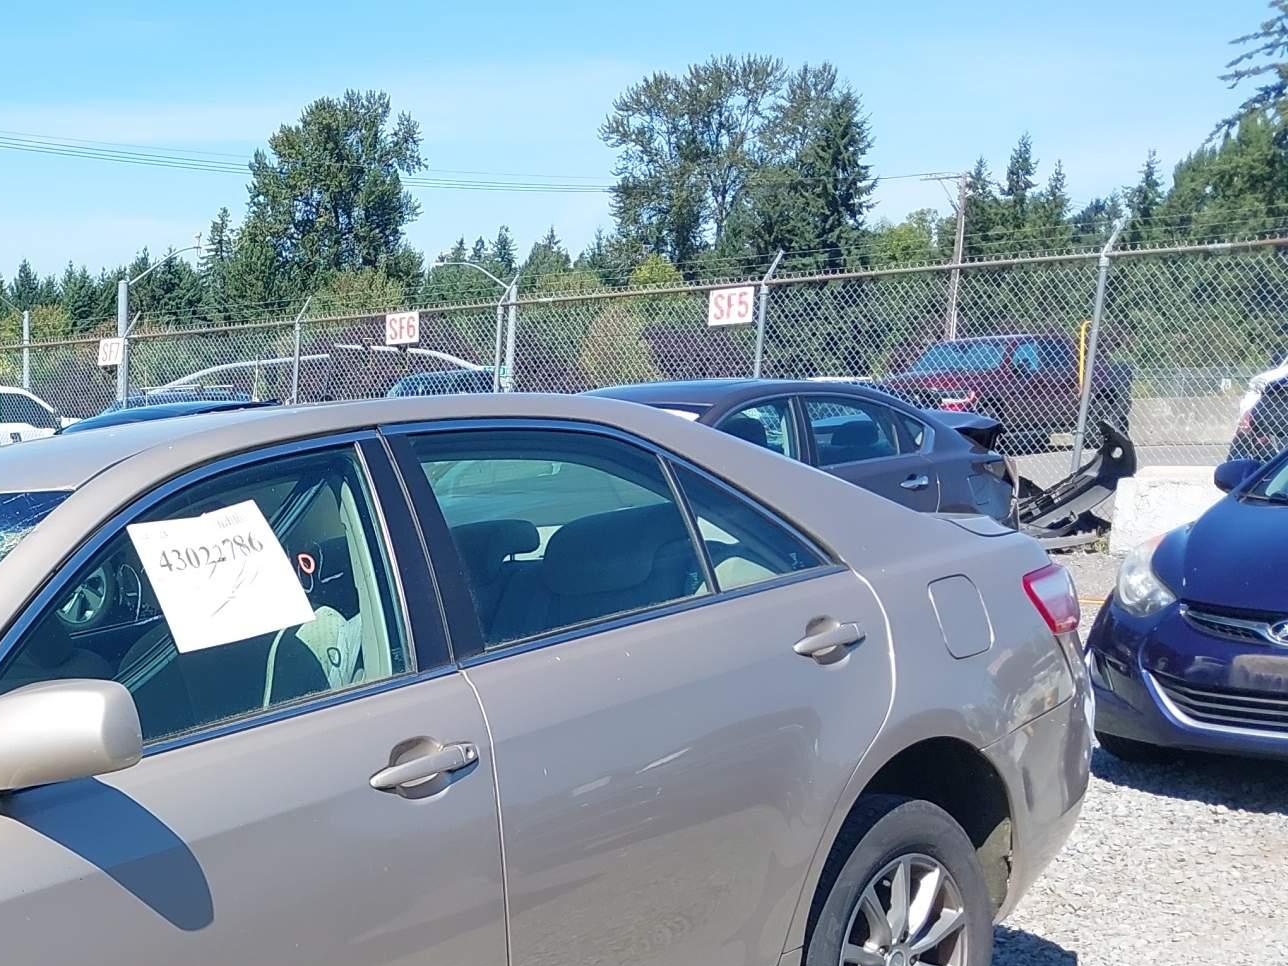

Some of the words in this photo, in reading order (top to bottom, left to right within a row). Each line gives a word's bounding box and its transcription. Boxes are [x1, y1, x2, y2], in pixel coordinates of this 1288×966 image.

[713, 291, 749, 320] SF5
[389, 315, 416, 341] SF6
[101, 341, 121, 362] SF7
[159, 532, 264, 572] 43022786
